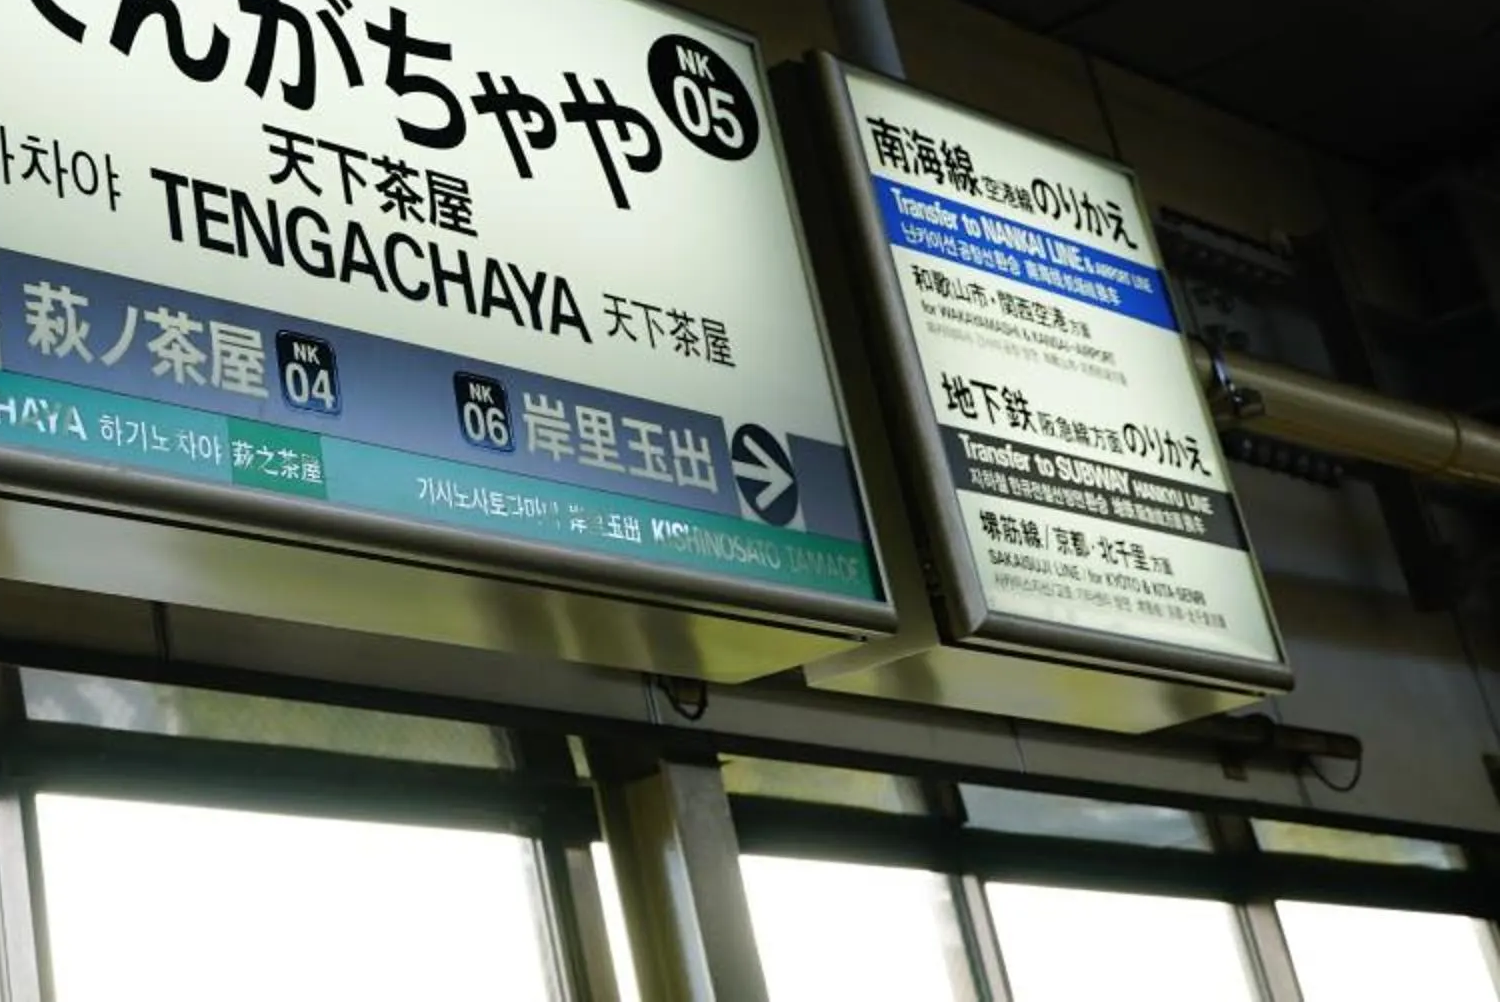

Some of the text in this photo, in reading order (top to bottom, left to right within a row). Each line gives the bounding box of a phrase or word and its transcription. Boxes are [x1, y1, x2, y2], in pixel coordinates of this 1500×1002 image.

[676, 45, 715, 82] NK
[673, 75, 745, 149] 05
[262, 123, 479, 237] 天下茶屋
[150, 167, 593, 344] TENGACHAYA
[890, 187, 958, 231] Transfer
[961, 213, 981, 239] to
[980, 215, 1046, 261] NANKAI
[1046, 237, 1087, 273] LINE
[24, 280, 269, 399] 萩ノ茶屋
[292, 341, 322, 366] NK
[603, 293, 737, 368] 天下茶屋
[284, 364, 336, 409] 04
[468, 381, 495, 405] NK
[461, 402, 510, 448] 06
[523, 392, 719, 494] 岸里玉出
[958, 433, 1031, 473] Transfer
[1033, 454, 1055, 479] to
[1055, 455, 1129, 496] SUBWAY
